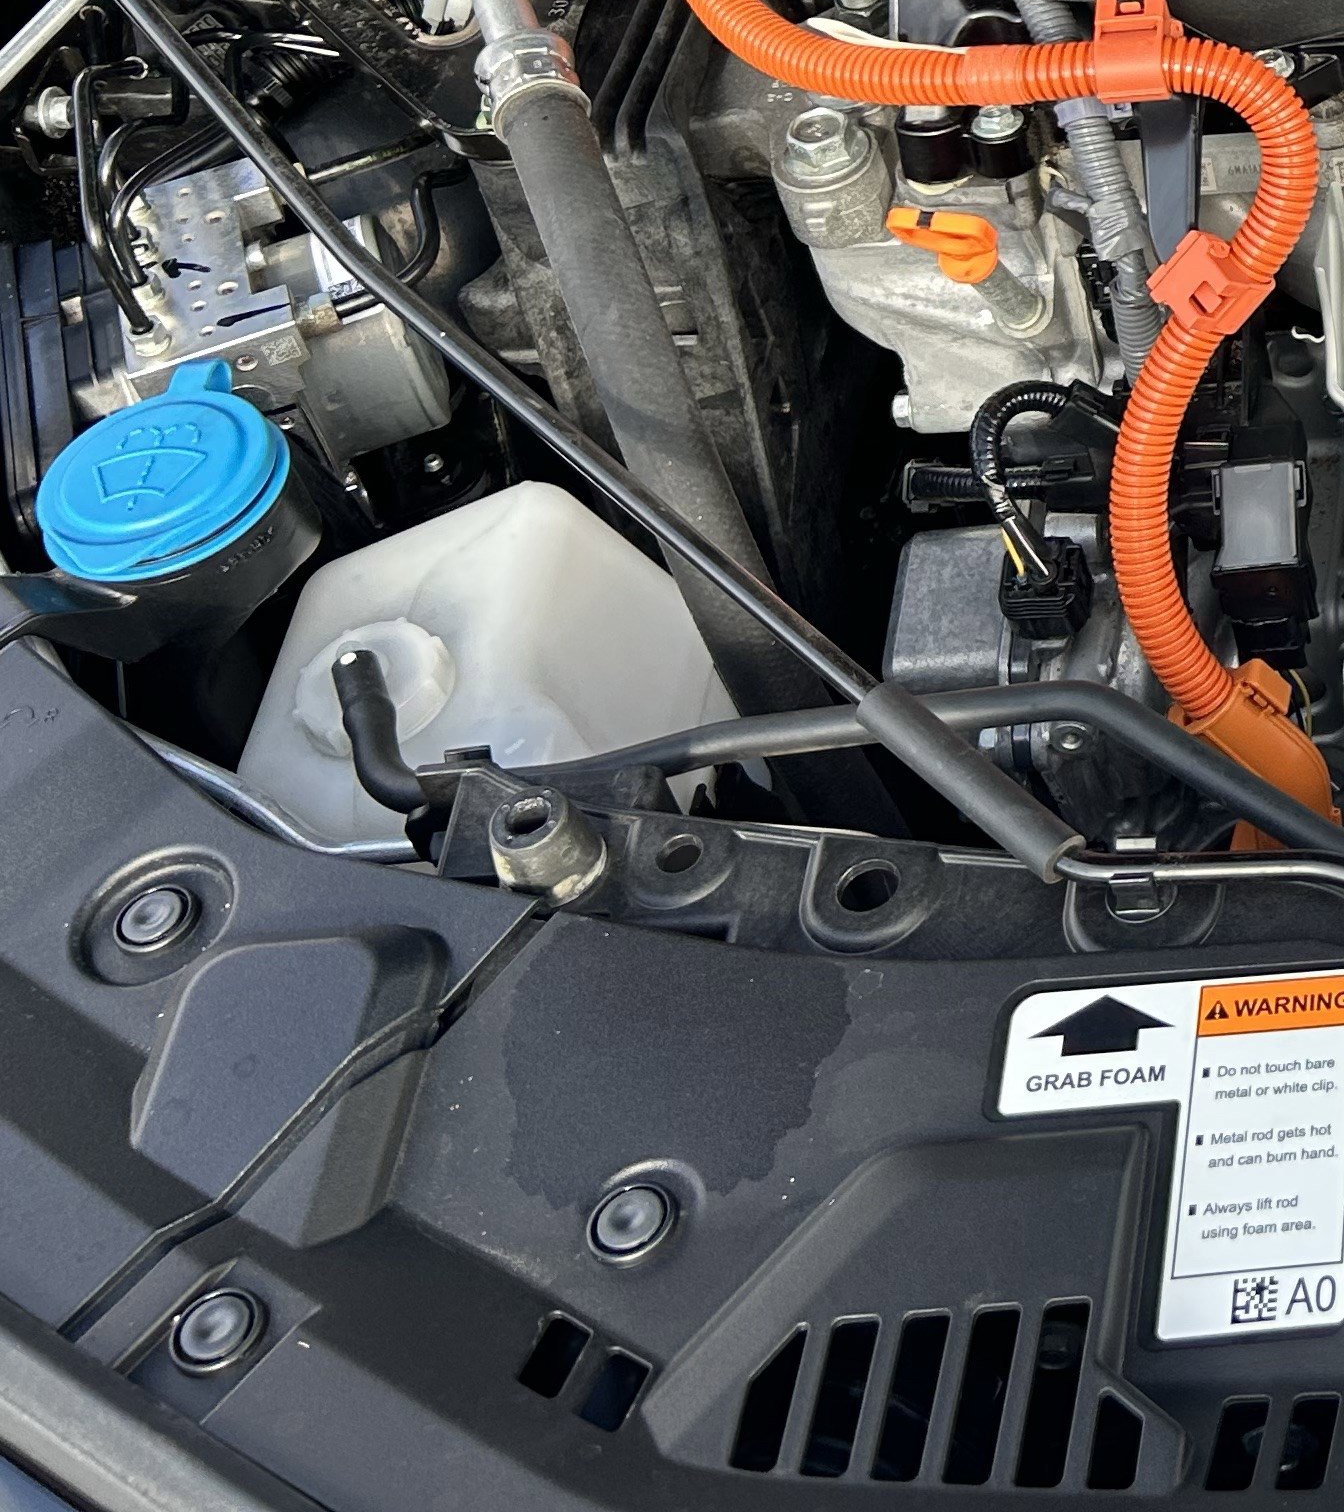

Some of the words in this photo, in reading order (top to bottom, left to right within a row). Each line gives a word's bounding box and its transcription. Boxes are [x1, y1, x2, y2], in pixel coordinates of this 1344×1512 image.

[1026, 1070, 1093, 1093] GRAB
[1100, 1064, 1167, 1086] FOAM
[1217, 1065, 1238, 1078] Do
[1240, 1063, 1263, 1076] not
[1265, 1060, 1302, 1074] touch
[1305, 1057, 1335, 1071] bare
[1215, 1086, 1252, 1100] metal
[1255, 1086, 1271, 1097] or
[1272, 1080, 1309, 1095] white
[1311, 1078, 1338, 1094] clip.
[1210, 1130, 1248, 1145] Metal
[1251, 1127, 1274, 1141] rod
[1277, 1126, 1306, 1142] gets
[1310, 1123, 1332, 1136] hot
[1208, 1155, 1234, 1169] and
[1238, 1154, 1262, 1166] can
[1266, 1150, 1297, 1163] burn
[1301, 1145, 1339, 1160] hand.
[1203, 1201, 1252, 1217] Always
[1256, 1197, 1272, 1211] lift
[1275, 1195, 1299, 1208] rod
[1201, 1226, 1238, 1241] using
[1242, 1222, 1278, 1235] foam
[1280, 1219, 1316, 1232] area.
